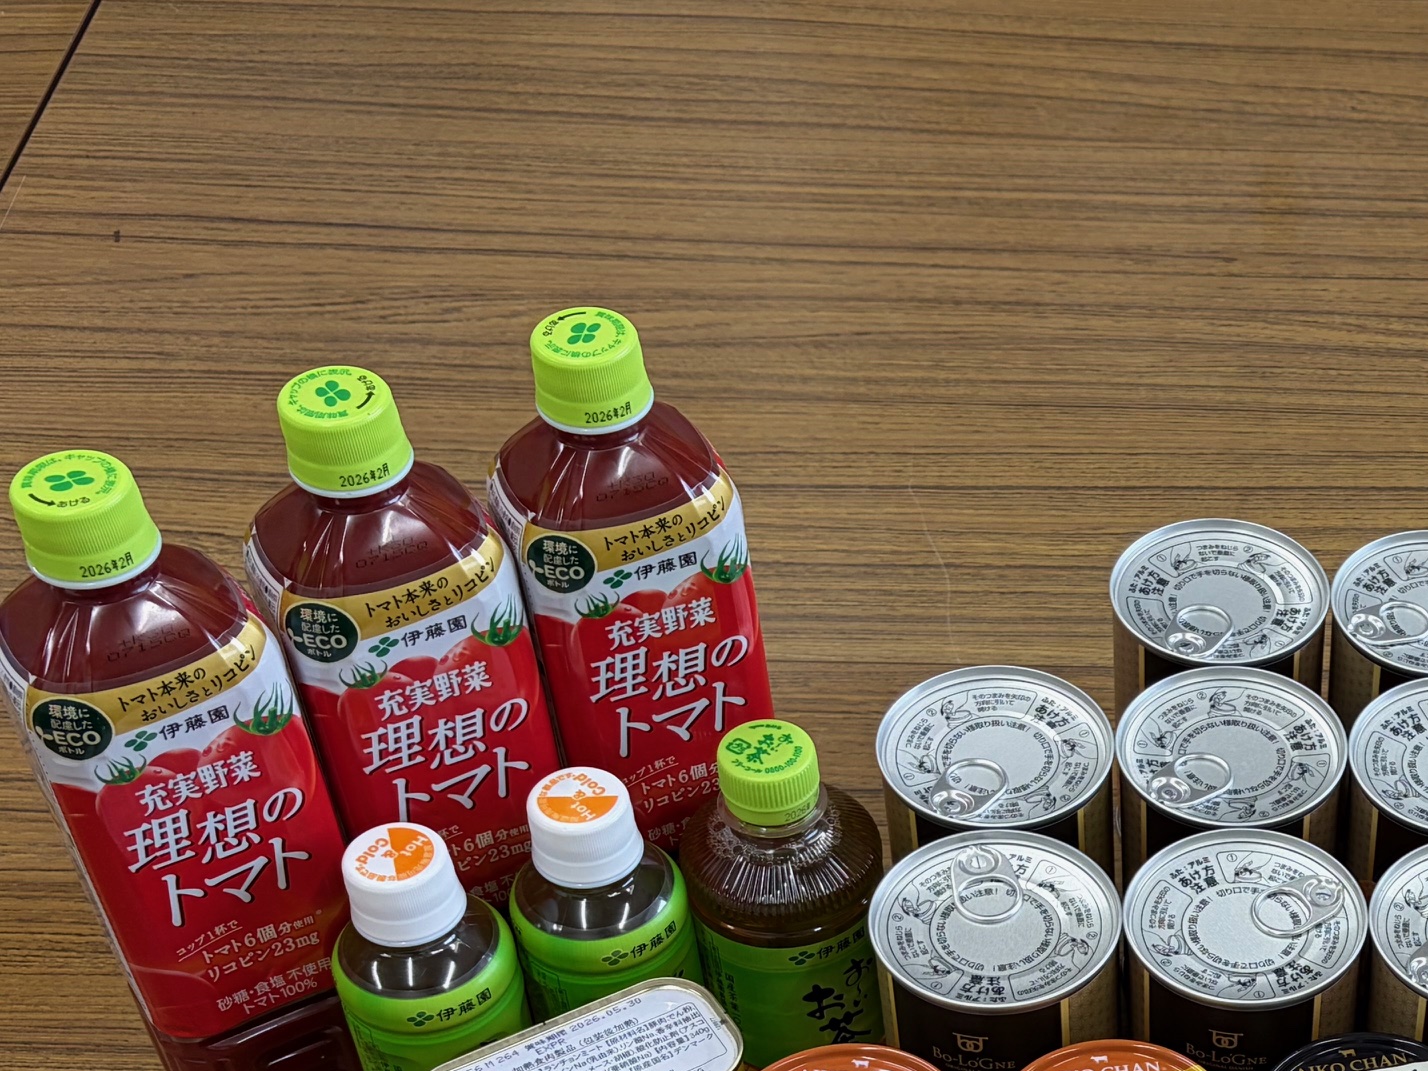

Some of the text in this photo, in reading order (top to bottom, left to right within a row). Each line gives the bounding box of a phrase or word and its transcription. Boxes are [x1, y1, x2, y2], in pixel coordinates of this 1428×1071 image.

[584, 401, 632, 424] 2026年2月
[338, 463, 391, 488] 2026年2月
[604, 513, 683, 551] トマト本来の
[621, 496, 725, 562] おいしさとリコピン
[542, 541, 578, 555] 環境に
[543, 555, 579, 566] 配慮した
[80, 552, 134, 578] 2026年2月
[543, 565, 585, 581] ECO
[634, 551, 697, 581] 伊藤園
[385, 555, 495, 629] おいしさとリコピン
[546, 578, 570, 588] ボトル
[365, 575, 449, 619] トマト本来の
[300, 608, 338, 623] 環境に
[605, 596, 716, 649] 充実野菜
[301, 623, 341, 635] 配慮した
[305, 633, 348, 650] ECO
[401, 614, 468, 648] 伊藤園
[307, 648, 332, 658] ボトル
[590, 635, 748, 704] 理想の
[117, 666, 206, 713] トマト本来の
[141, 649, 255, 722] おいしさとリコピン
[374, 660, 493, 722] 充実野菜
[48, 704, 89, 719] 環境に
[158, 705, 229, 740] 伊藤園
[615, 682, 747, 757] トマト
[51, 718, 93, 732] 配慮した
[361, 697, 528, 775] 理想の
[1293, 725, 1317, 751] あけ方
[1389, 713, 1422, 737] あけ方
[1406, 724, 1427, 742] 注意
[56, 731, 101, 748] ECO
[58, 745, 85, 756] ボトル
[1284, 731, 1303, 752] 注意
[135, 751, 262, 817] 充実野菜
[394, 745, 530, 824] トマト
[571, 773, 606, 796] Cold
[570, 802, 596, 822] Hot
[124, 786, 303, 875] 理想の
[355, 838, 389, 865] Cold
[400, 835, 428, 857] Hot
[160, 838, 310, 928] トマト
[1178, 865, 1216, 888] あけ方
[1191, 876, 1220, 895] 注意
[176, 919, 238, 957] コップ1杯で
[629, 921, 677, 958] 伊藤園
[817, 926, 866, 960] 伊藤園
[207, 931, 320, 983] リコピン23mg
[243, 977, 318, 1015] トマト100%
[436, 987, 492, 1022] 伊藤園
[569, 996, 642, 1032] 2026.05.30
[802, 984, 872, 1044] お茶
[497, 1048, 520, 1063] 264
[535, 1037, 566, 1055] EXPR
[1350, 1053, 1408, 1071] CHAN
